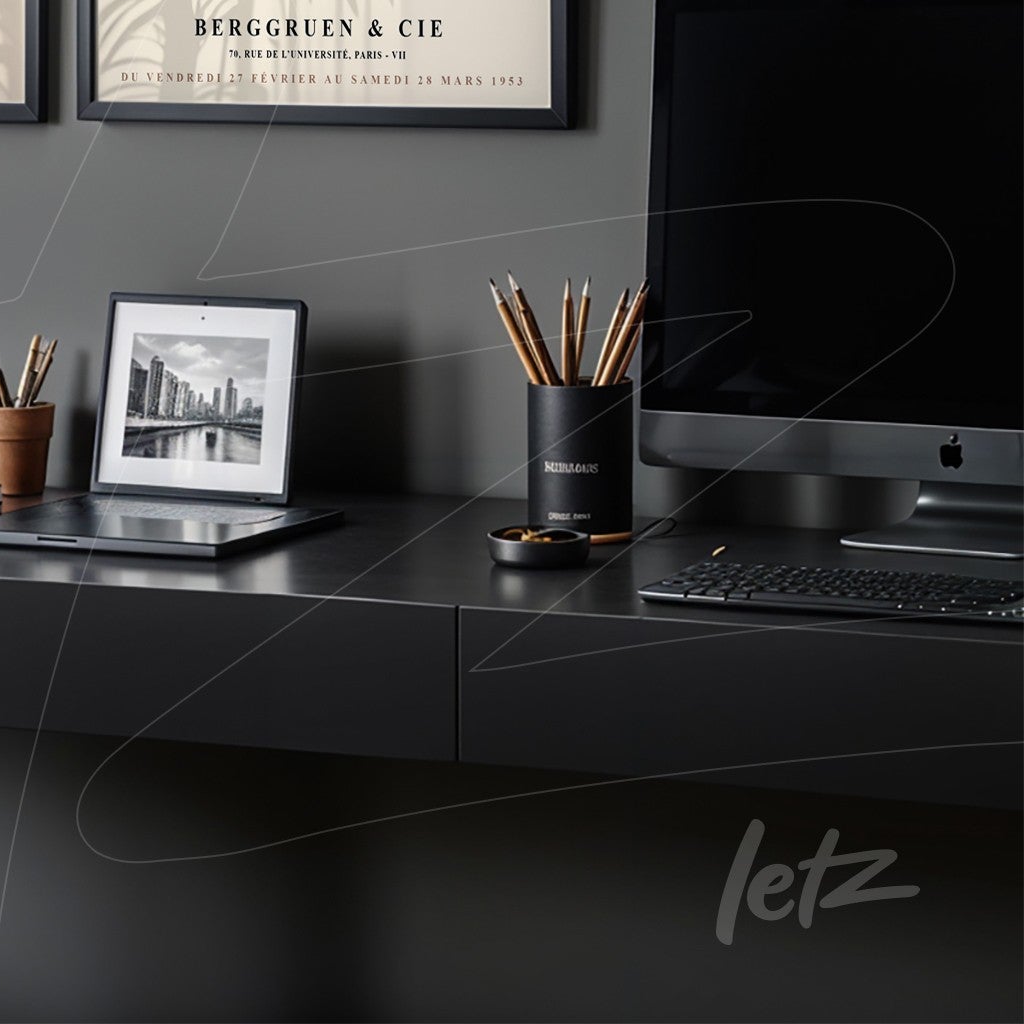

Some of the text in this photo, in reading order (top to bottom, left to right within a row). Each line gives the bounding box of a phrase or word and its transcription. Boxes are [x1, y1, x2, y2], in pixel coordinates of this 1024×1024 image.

[194, 18, 444, 38] BERGGRUEN & CIE
[228, 49, 242, 60] 70,
[244, 49, 263, 59] RUE
[266, 49, 278, 59] DE
[354, 50, 382, 60] PARIS
[392, 50, 406, 60] VII
[121, 71, 524, 86] DU VENDREDI 27 FÉVRIER AU SAMEDI 28 MARS 1953
